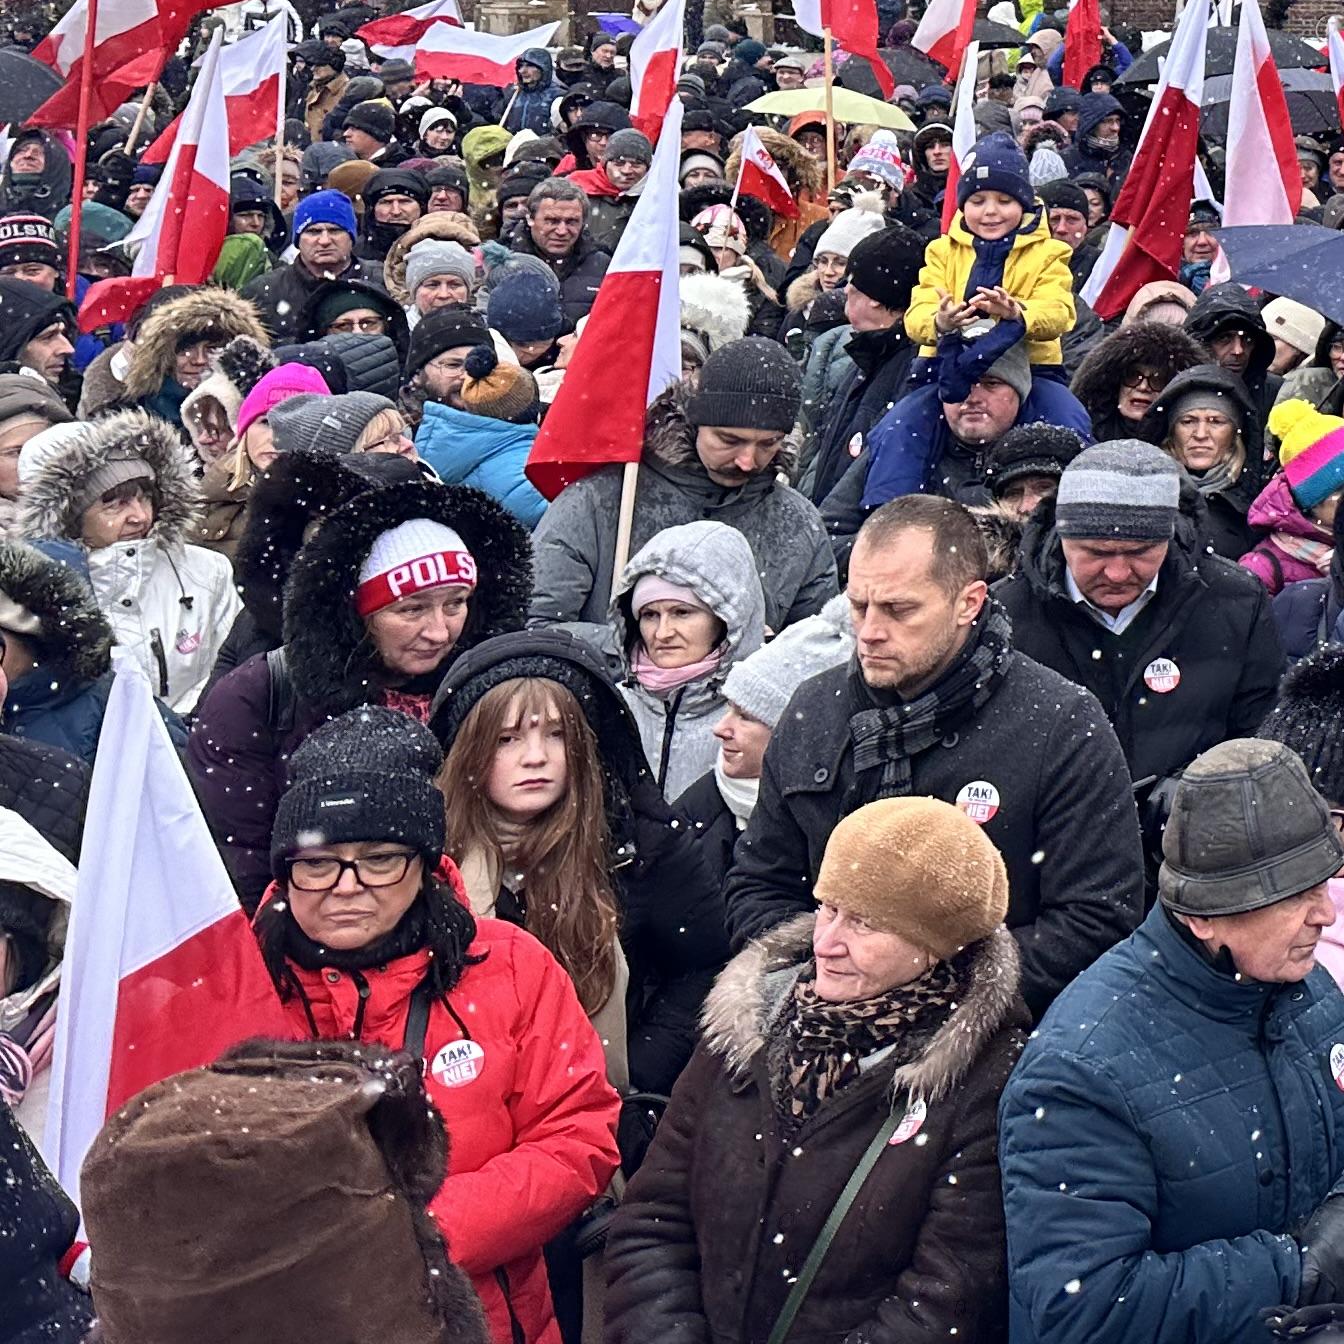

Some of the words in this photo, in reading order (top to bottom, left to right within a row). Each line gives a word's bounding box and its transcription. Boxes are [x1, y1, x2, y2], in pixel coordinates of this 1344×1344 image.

[386, 552, 477, 597] POLS
[967, 786, 992, 800] TAK!
[440, 1043, 473, 1065] TAK!
